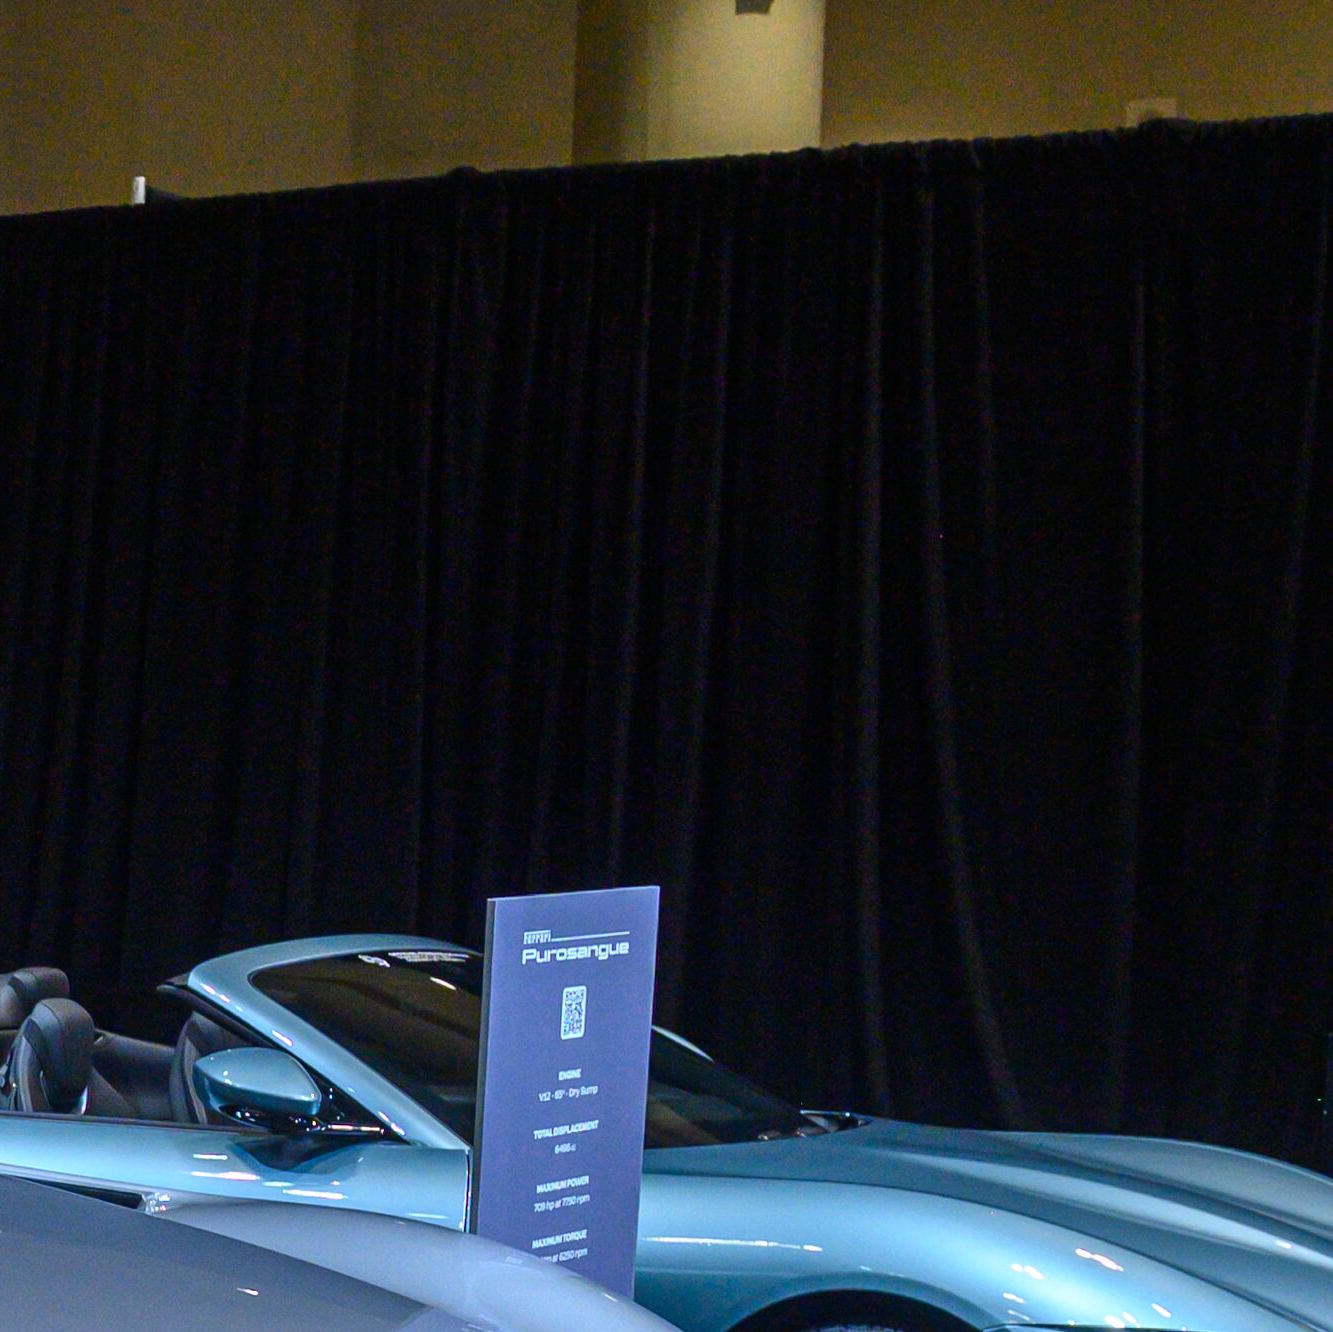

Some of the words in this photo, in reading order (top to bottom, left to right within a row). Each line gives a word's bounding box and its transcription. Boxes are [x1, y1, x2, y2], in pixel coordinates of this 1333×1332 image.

[521, 942, 630, 965] Purosangue
[558, 1068, 582, 1081] ENGINE
[568, 1087, 580, 1098] Dry
[580, 1085, 598, 1096] Sump
[533, 1128, 553, 1140] TOTAL
[553, 1120, 600, 1137] DISPLACEMENT
[536, 1180, 567, 1194] MAXIMUM
[566, 1175, 590, 1188] POWER
[532, 1235, 563, 1249] MAXIMUM
[562, 1228, 588, 1243] TORQUE
